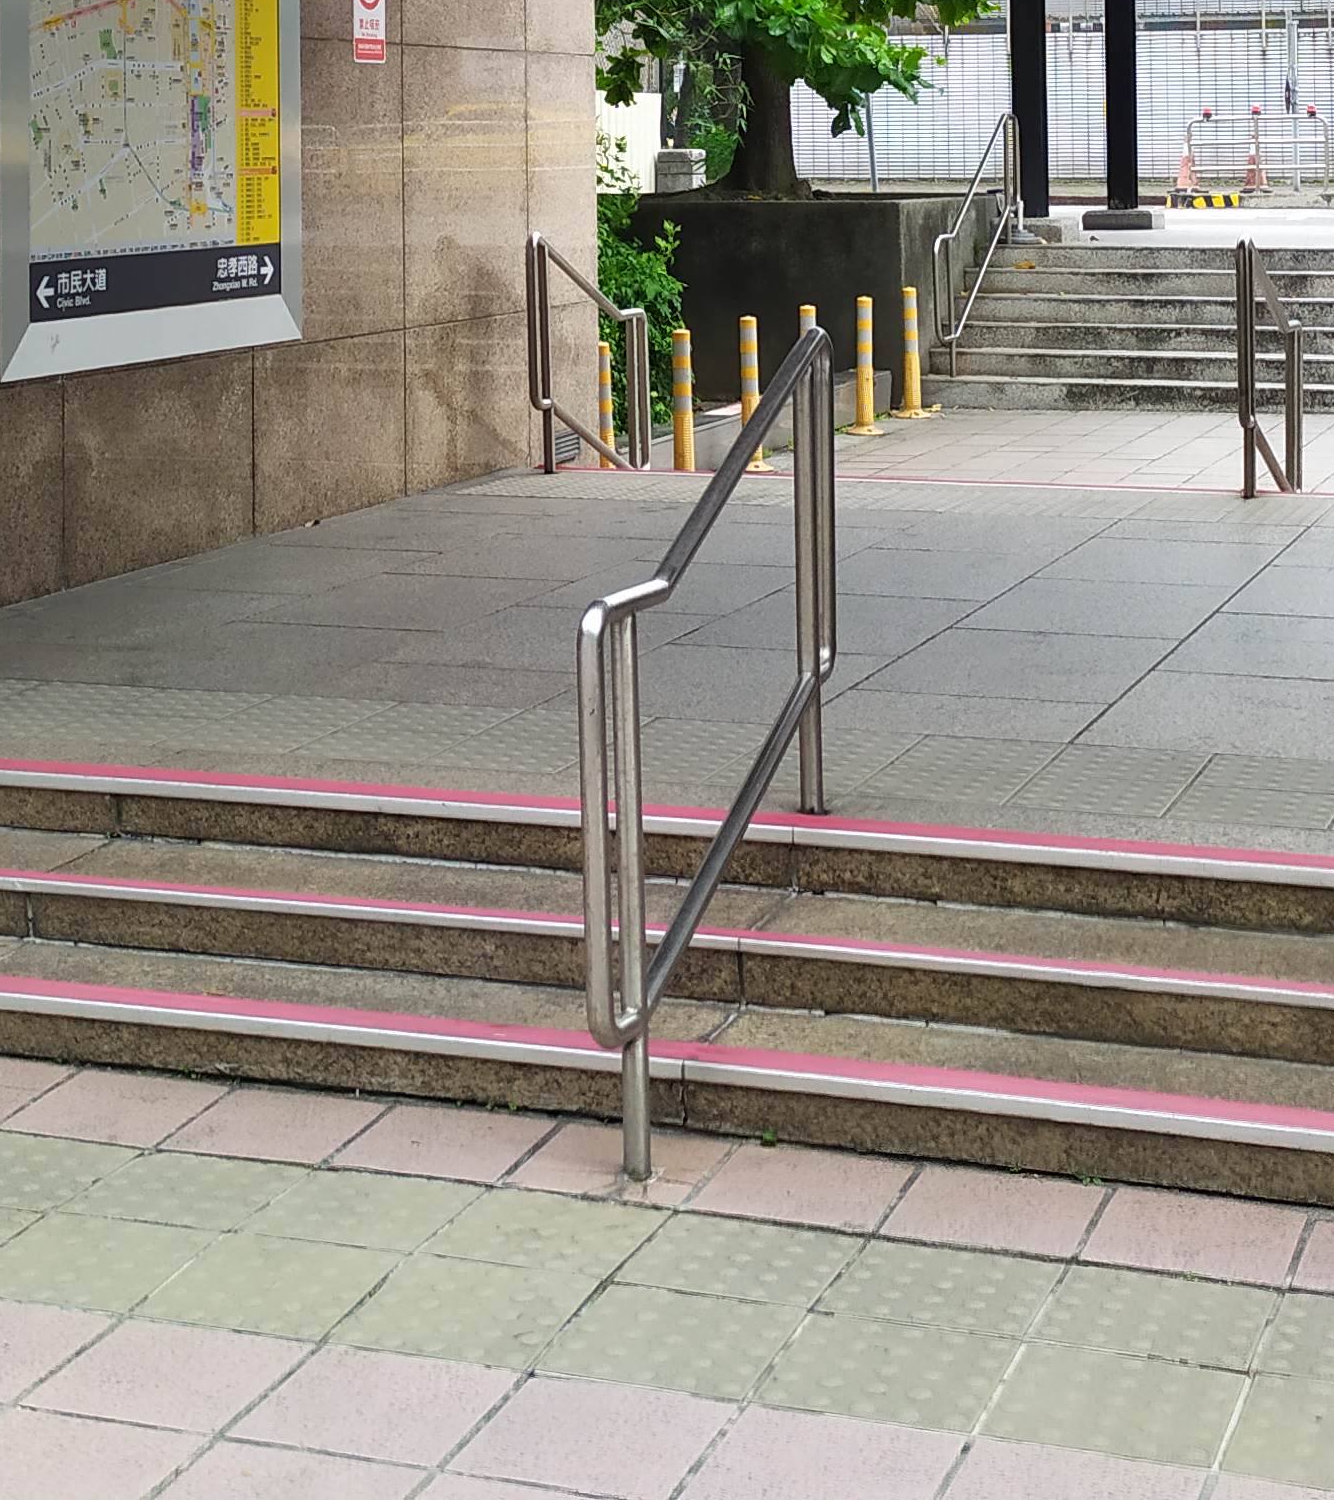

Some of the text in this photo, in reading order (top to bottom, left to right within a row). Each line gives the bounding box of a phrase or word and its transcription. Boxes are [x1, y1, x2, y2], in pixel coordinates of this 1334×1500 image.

[216, 255, 258, 279] 忠孝西路
[56, 268, 107, 295] 市民大道
[248, 277, 259, 288] Rd.
[56, 295, 92, 310] Civic Blvd.
